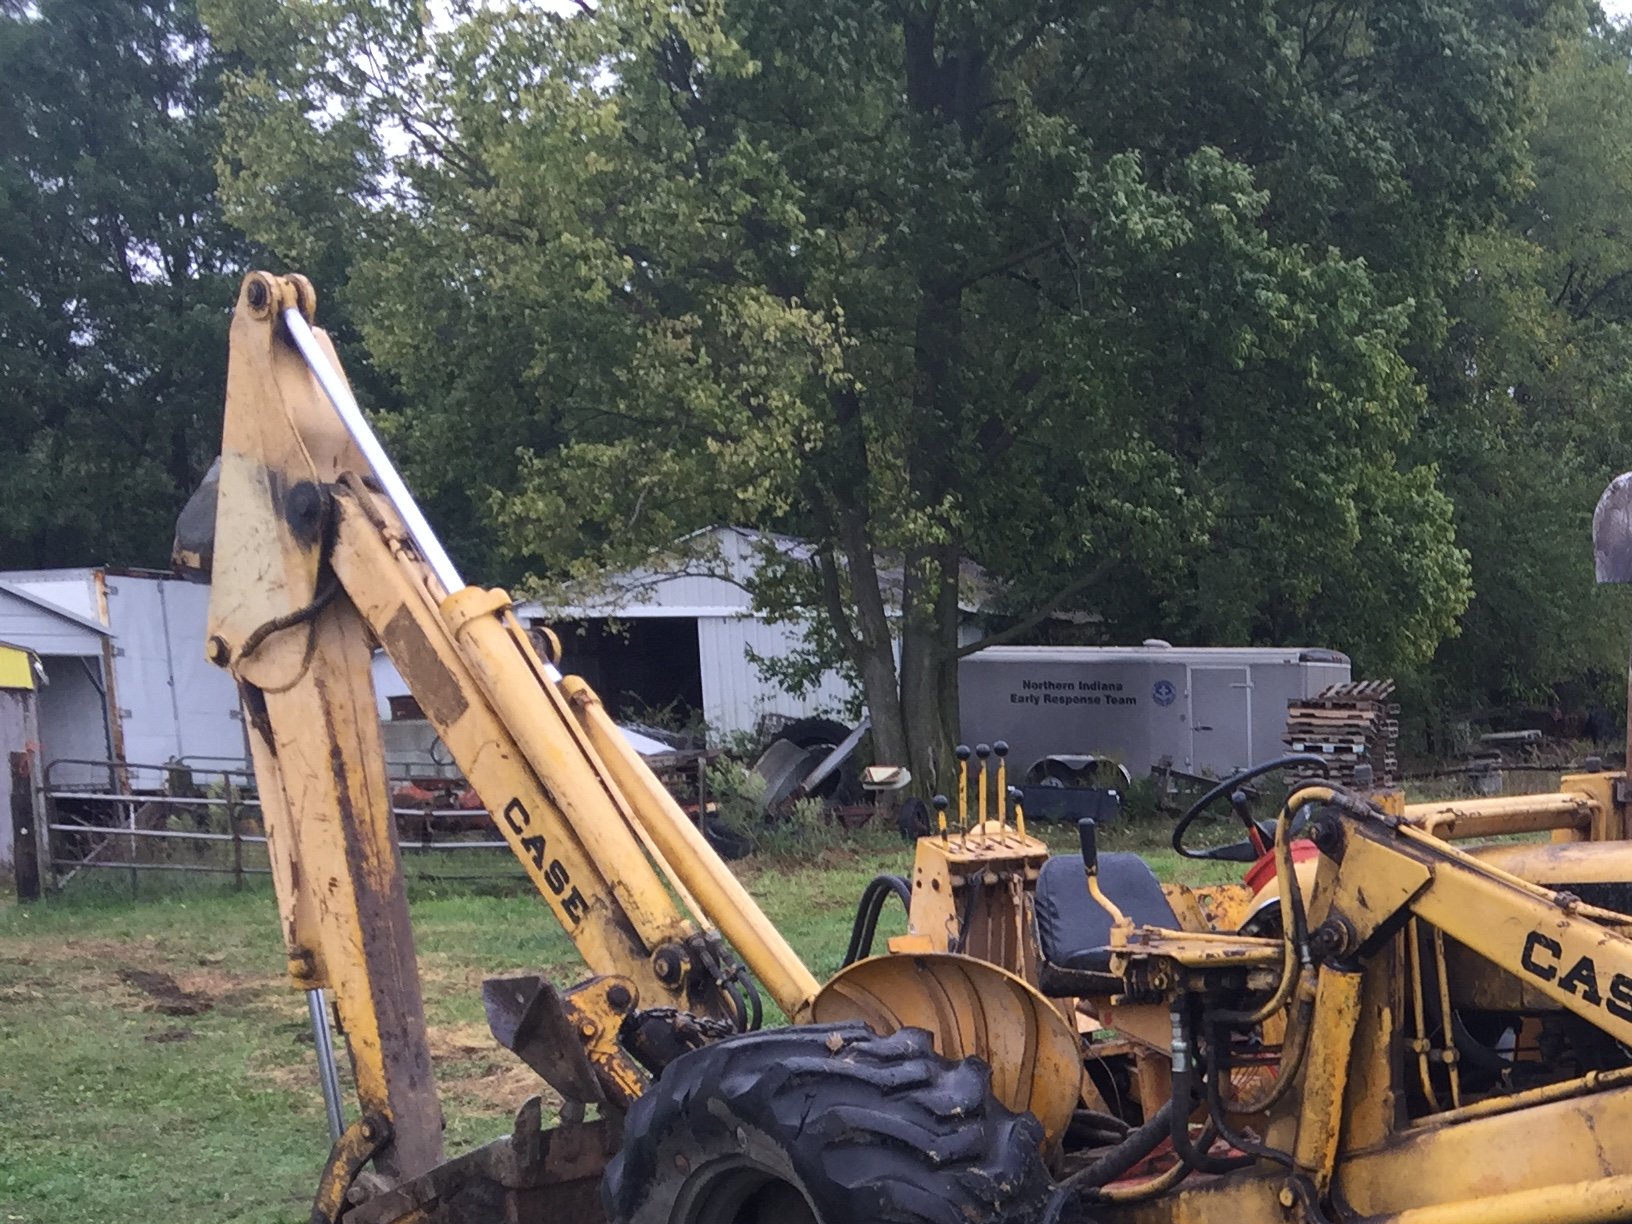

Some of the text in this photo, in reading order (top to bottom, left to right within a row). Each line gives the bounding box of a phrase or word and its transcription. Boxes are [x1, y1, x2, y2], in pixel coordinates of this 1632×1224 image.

[1022, 680, 1123, 691] Northern Indiana
[1010, 694, 1137, 706] Early Response Team
[504, 797, 590, 925] CASE
